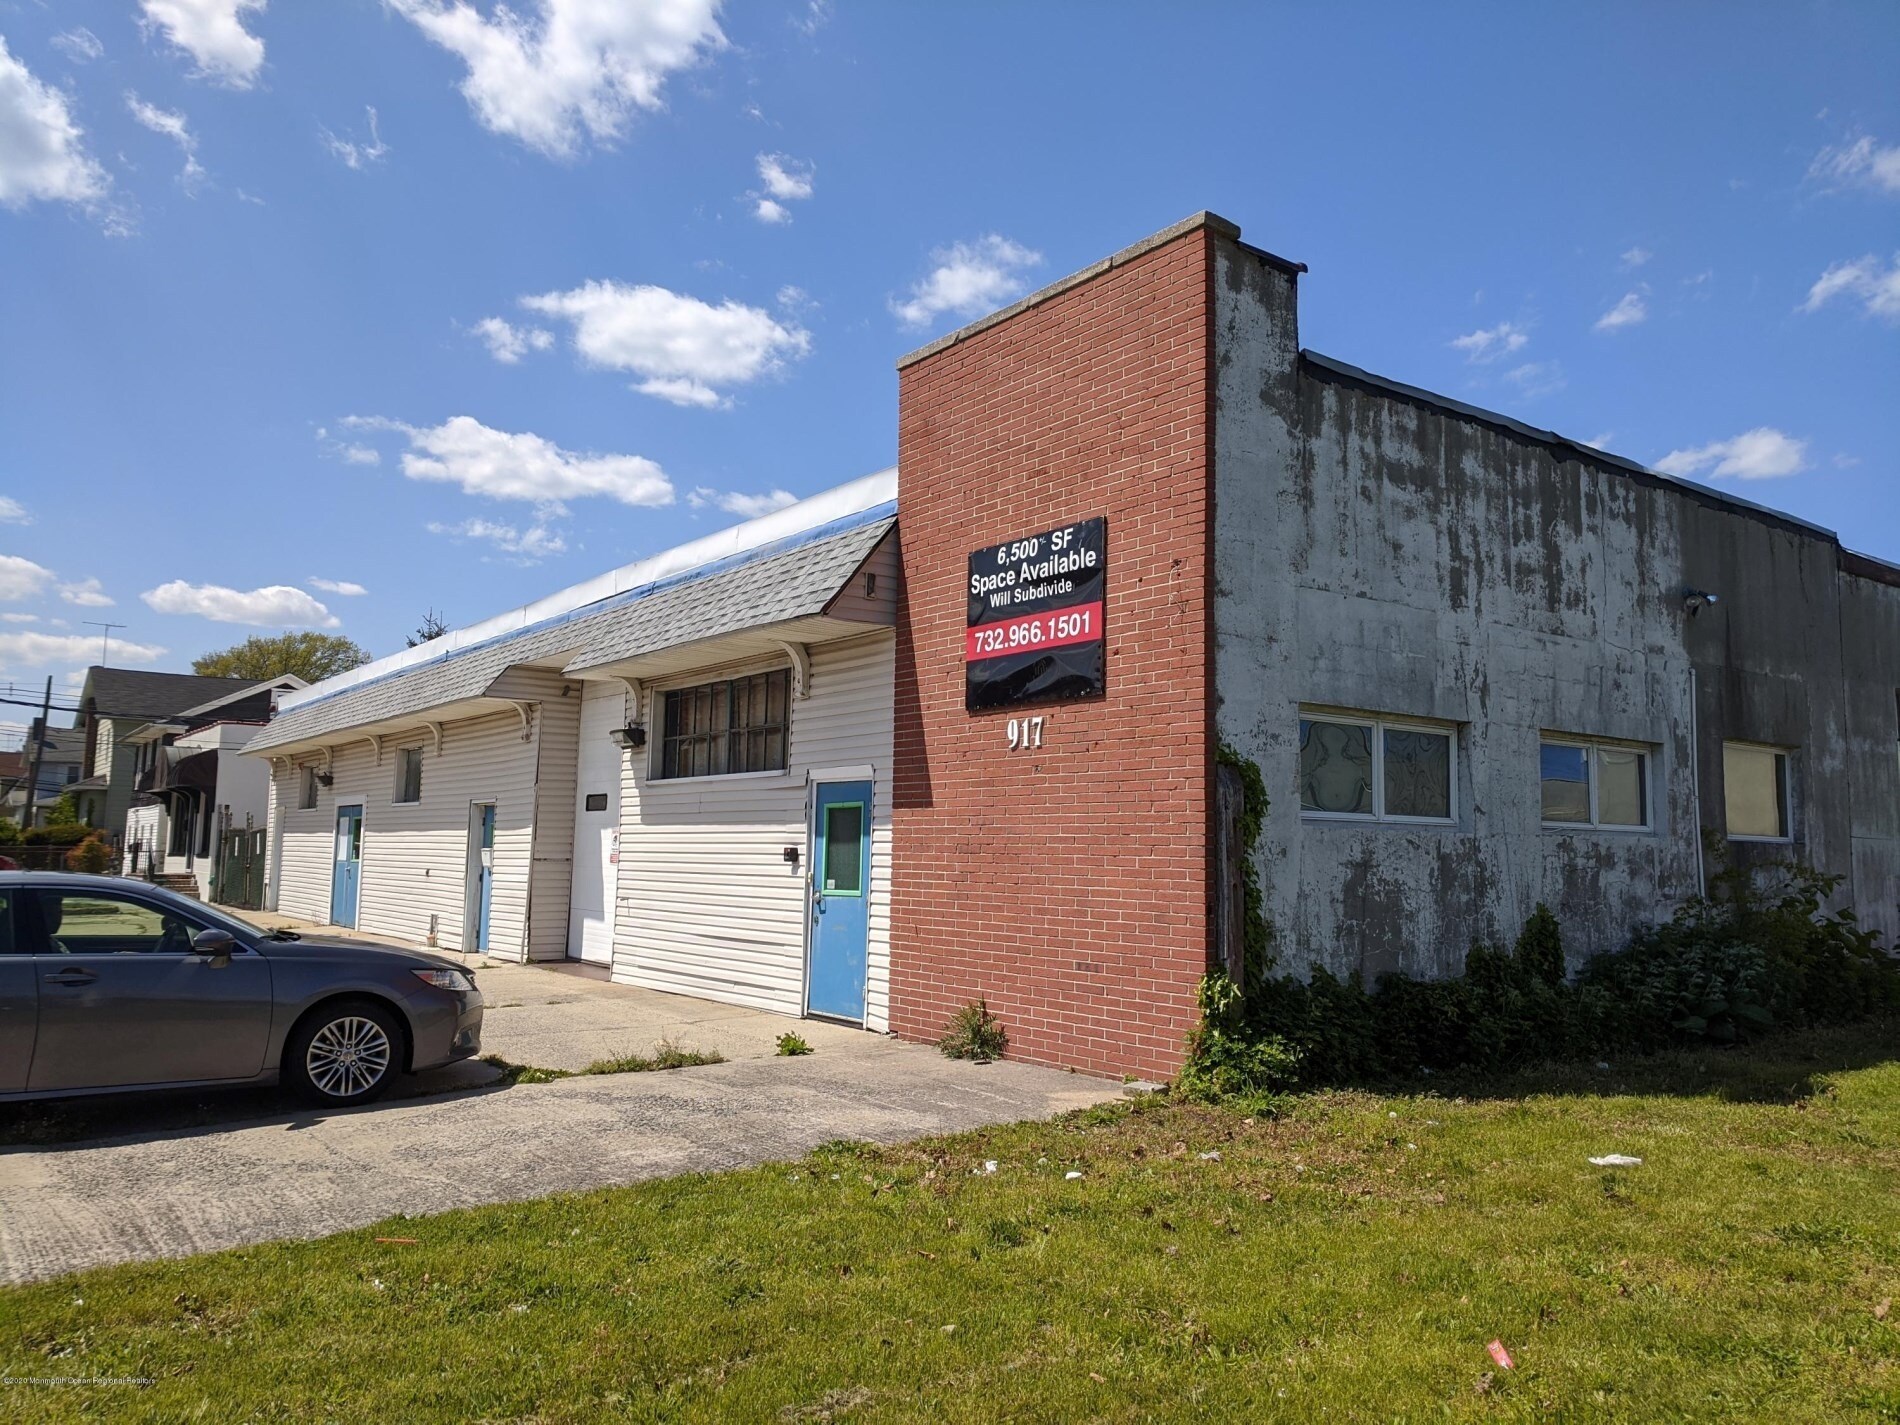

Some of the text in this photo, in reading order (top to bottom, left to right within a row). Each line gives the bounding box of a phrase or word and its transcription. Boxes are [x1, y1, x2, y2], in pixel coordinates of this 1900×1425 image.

[1050, 527, 1074, 551] SF
[971, 547, 1097, 596] Space Available
[990, 578, 1073, 608] Will Subdivide
[974, 610, 1090, 653] 732.966.1501
[1007, 717, 1044, 749] 917
